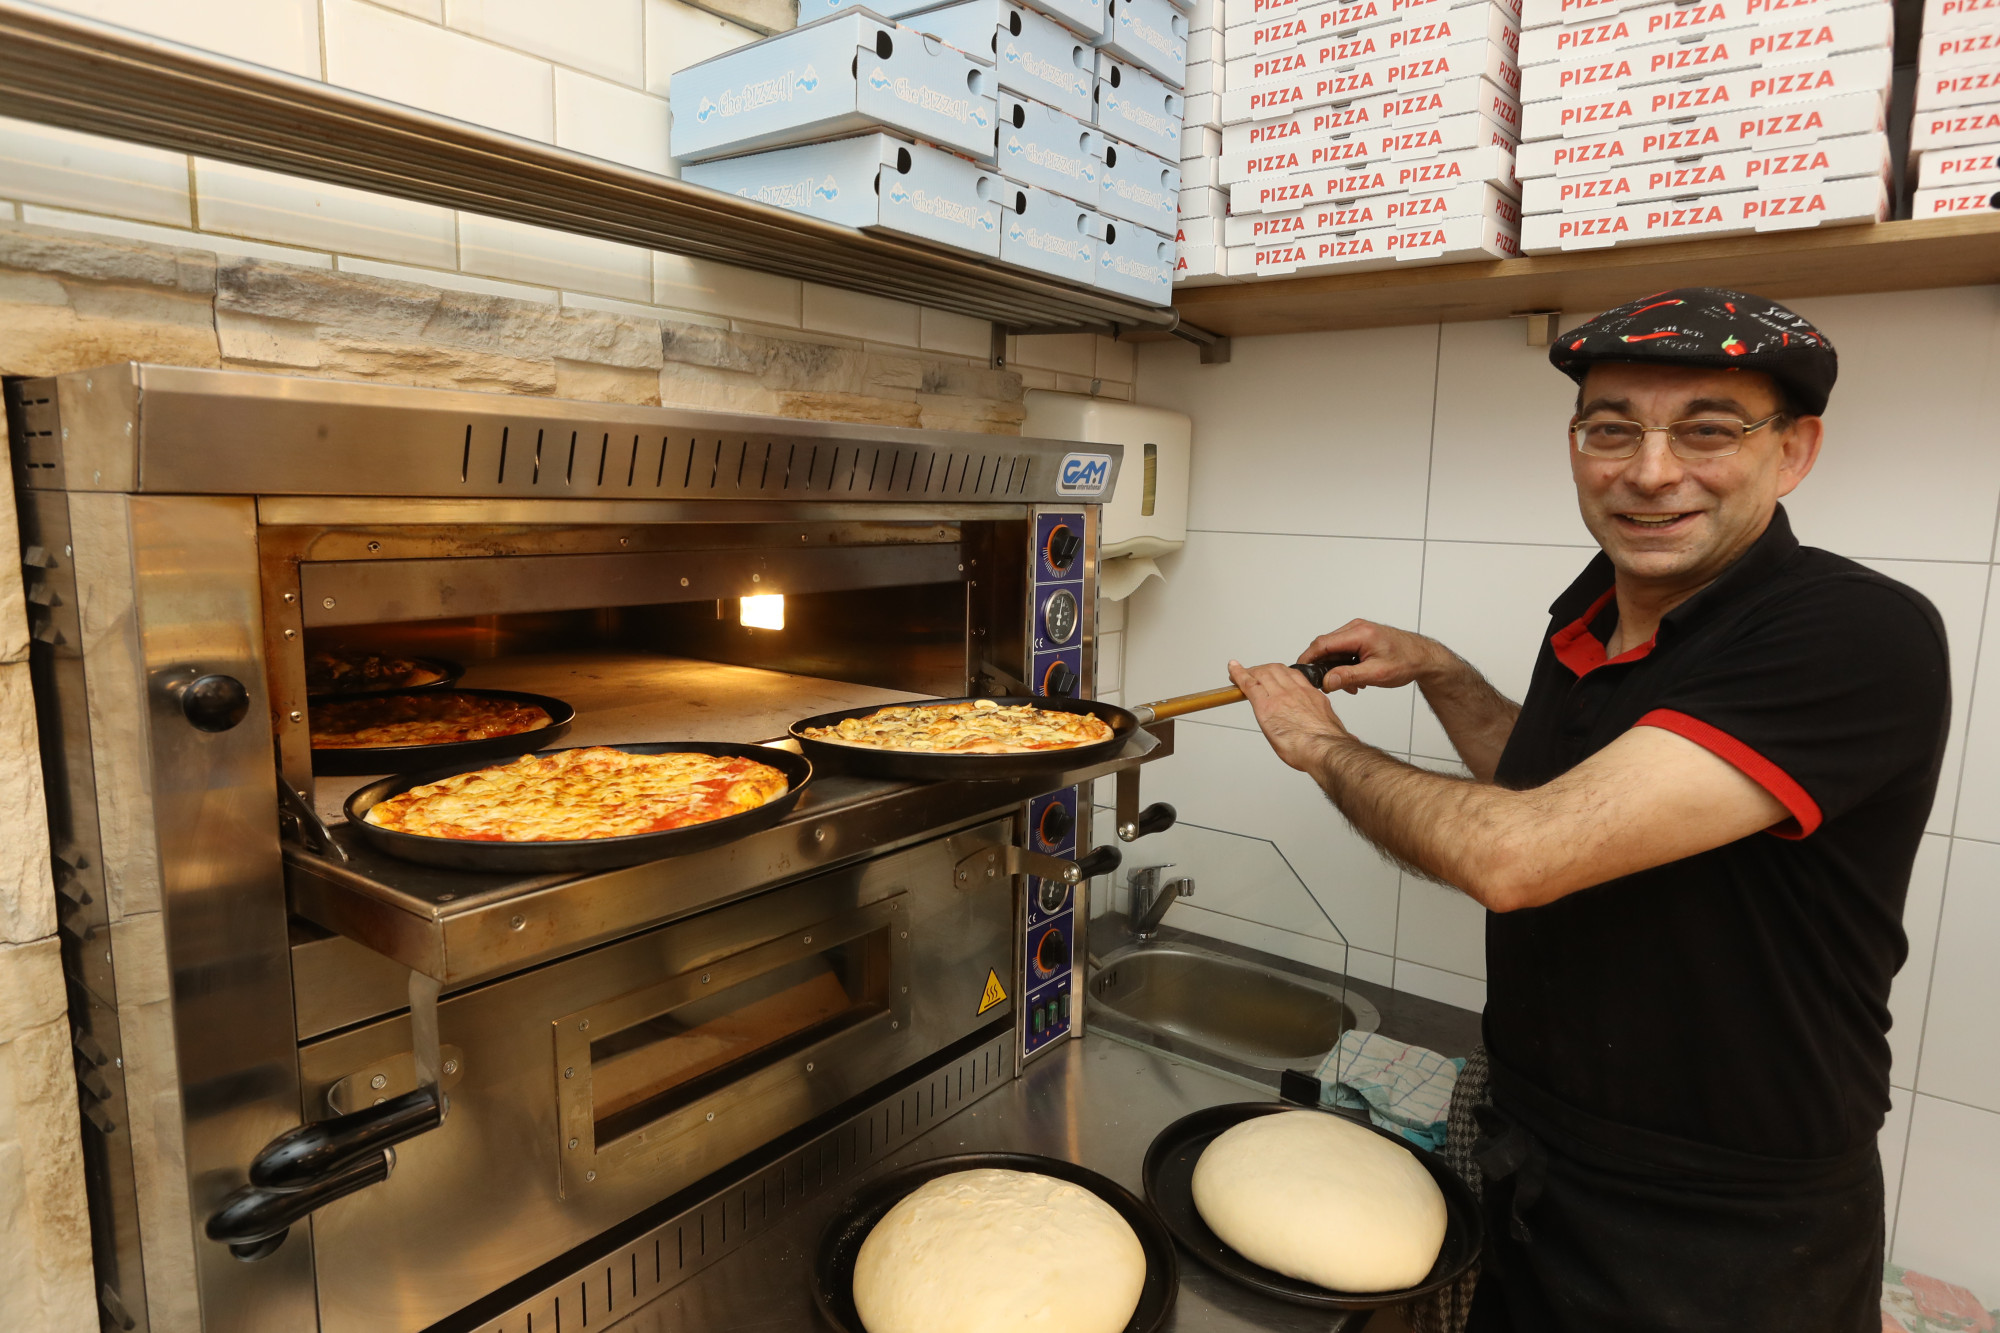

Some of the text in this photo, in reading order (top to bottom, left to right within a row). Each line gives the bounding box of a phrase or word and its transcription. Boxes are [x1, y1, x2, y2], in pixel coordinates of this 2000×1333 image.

[1254, 20, 1307, 45] PIZZA
[1321, 2, 1378, 28] PIZZA
[1558, 22, 1629, 50] PIZZA
[1648, 3, 1726, 32] PIZZA
[1942, 0, 2000, 16] PIZZ
[1255, 22, 1451, 78] PIZZA PIZZA PIZZA
[1502, 25, 1520, 53] PIZZ
[1560, 26, 1834, 87] PIZZA PIZZA PIZZA
[1251, 58, 1450, 109] PIZZA PIZZA PIZZA
[1561, 70, 1835, 125] PIZZA PIZZA PIZZA
[1250, 94, 1443, 143] PIZZA PIZZA PIZZA
[1493, 96, 1516, 126] PIZZA
[1931, 113, 2000, 135] PIZZA
[1248, 130, 1442, 173] PIZZA PIZZA PIZZA
[1554, 111, 1823, 165] PIZZA PIZZA PIZZA
[1261, 162, 1461, 203] PIZZA PIZZA PIZZA
[1561, 152, 1830, 200] PIZZA PIZZA PIZZA
[1940, 155, 1997, 174] PIZZ
[1254, 197, 1447, 236] PIZZA PIZZA PIZZA
[1496, 199, 1517, 223] PIZZA
[1560, 194, 1826, 238] PIZZA PIZZA PIZZA
[1933, 195, 1991, 213] PIZZ
[1256, 229, 1446, 265] PIZZA PIZZA PIZZA
[1496, 232, 1517, 256] PIZZA
[1063, 460, 1107, 484] GAM
